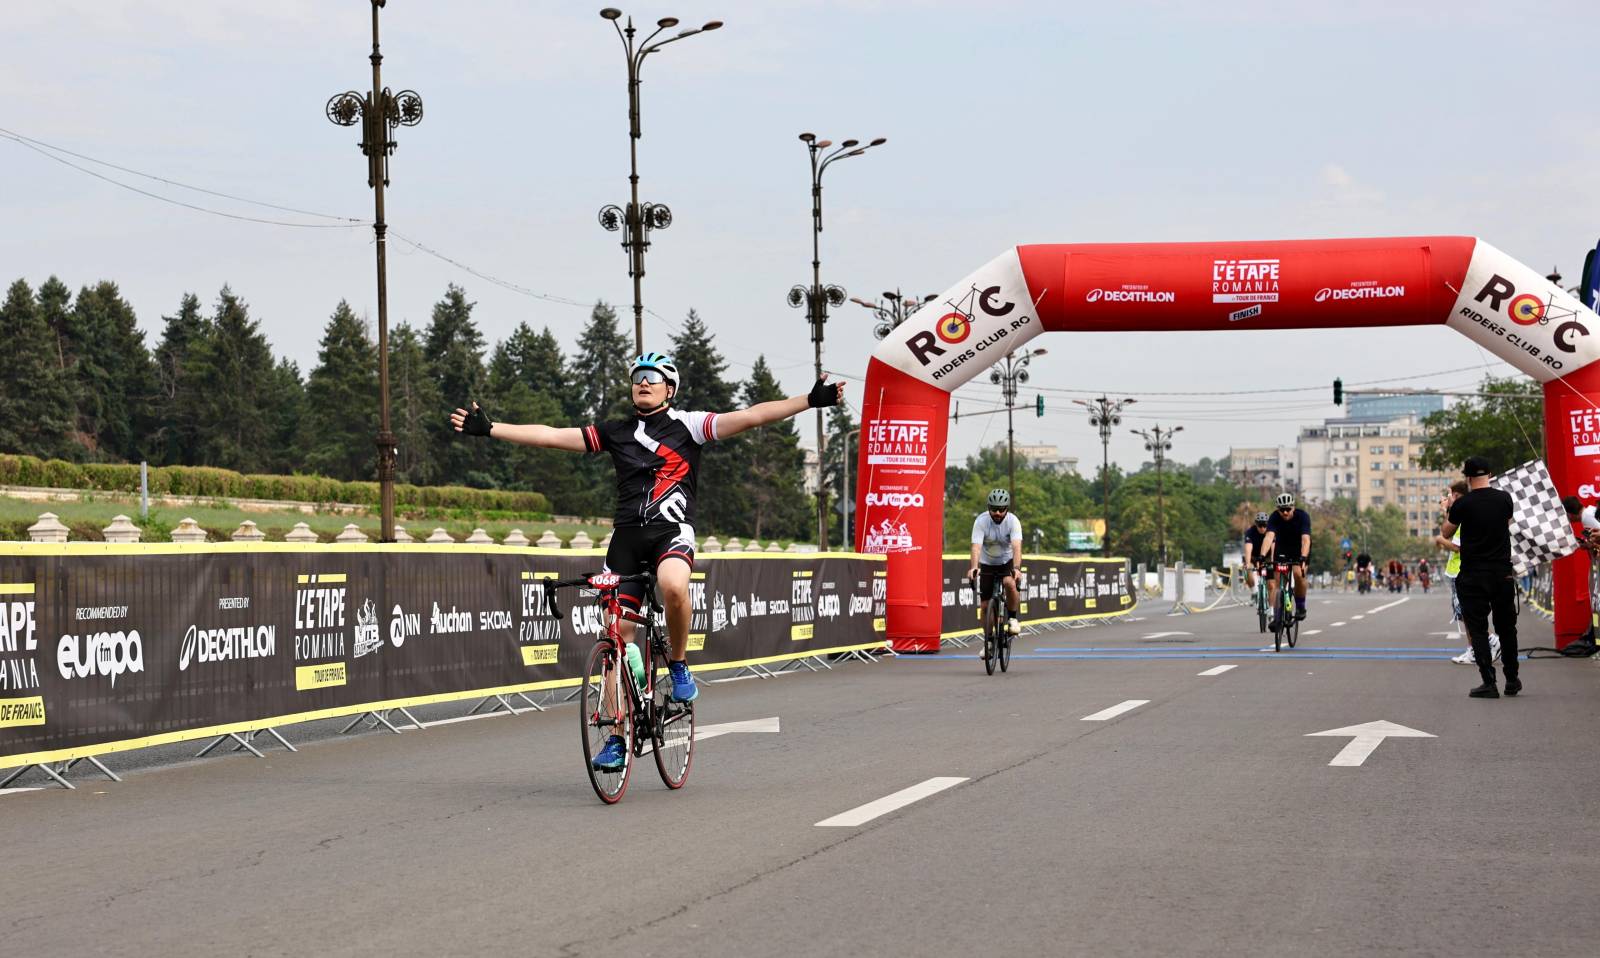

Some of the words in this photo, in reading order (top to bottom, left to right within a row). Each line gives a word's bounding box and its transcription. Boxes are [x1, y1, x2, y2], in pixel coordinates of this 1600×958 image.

[1213, 281, 1278, 292] ROMANIA
[1333, 286, 1405, 300] DECATHLON
[1104, 291, 1175, 302] DECATHLON
[1233, 306, 1259, 320] FINISH
[1460, 307, 1506, 336] RIDERS
[1506, 334, 1541, 357] CLUB
[932, 350, 975, 380] RIDERS
[975, 328, 1008, 352] CLUB
[868, 443, 927, 454] ROMANIA
[866, 492, 924, 510] europa
[866, 535, 912, 548] MTB
[76, 607, 120, 620] RECOMMENDED
[120, 606, 129, 618] BY
[430, 601, 473, 634] Auchan
[354, 624, 380, 644] MTB
[520, 620, 561, 641] ROMANIA
[198, 625, 276, 663] DECATHLON
[295, 632, 345, 660] ROMANIA
[57, 630, 144, 689] europa
[1, 704, 13, 721] DE
[12, 702, 43, 720] FRANCE
